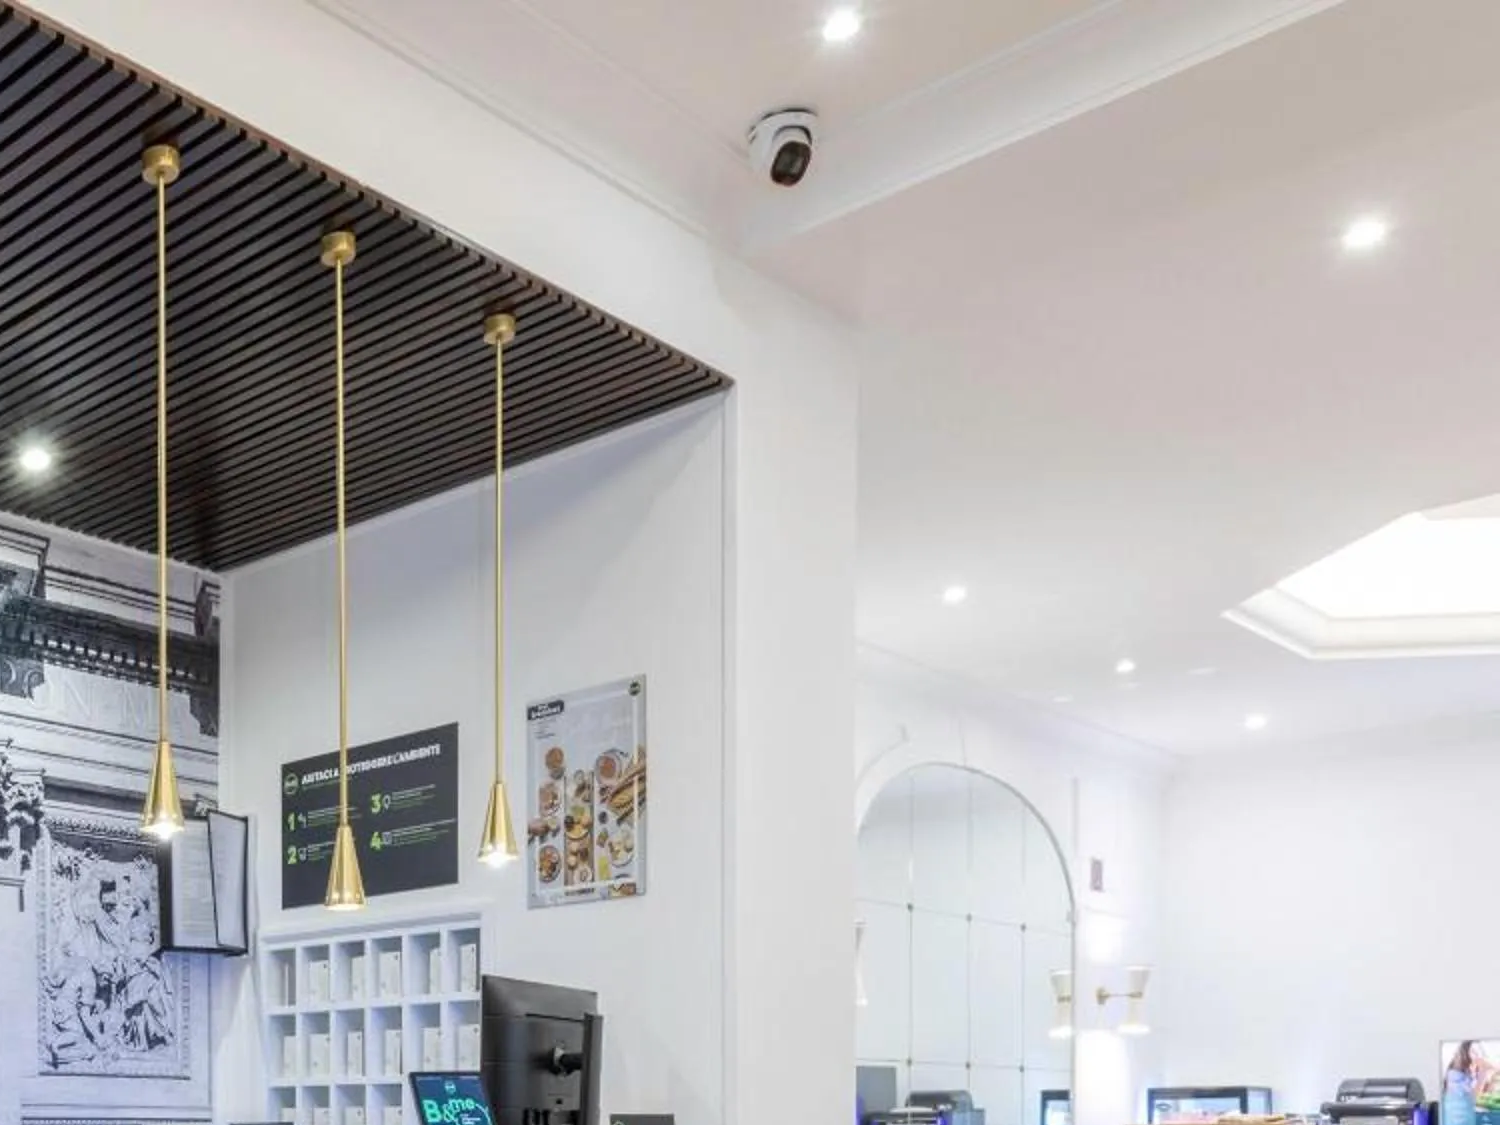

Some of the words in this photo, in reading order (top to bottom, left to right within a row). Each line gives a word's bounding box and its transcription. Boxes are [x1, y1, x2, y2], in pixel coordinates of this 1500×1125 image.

[369, 792, 382, 814] 3
[287, 812, 296, 832] 1
[369, 831, 382, 850] 4
[287, 846, 297, 865] 2
